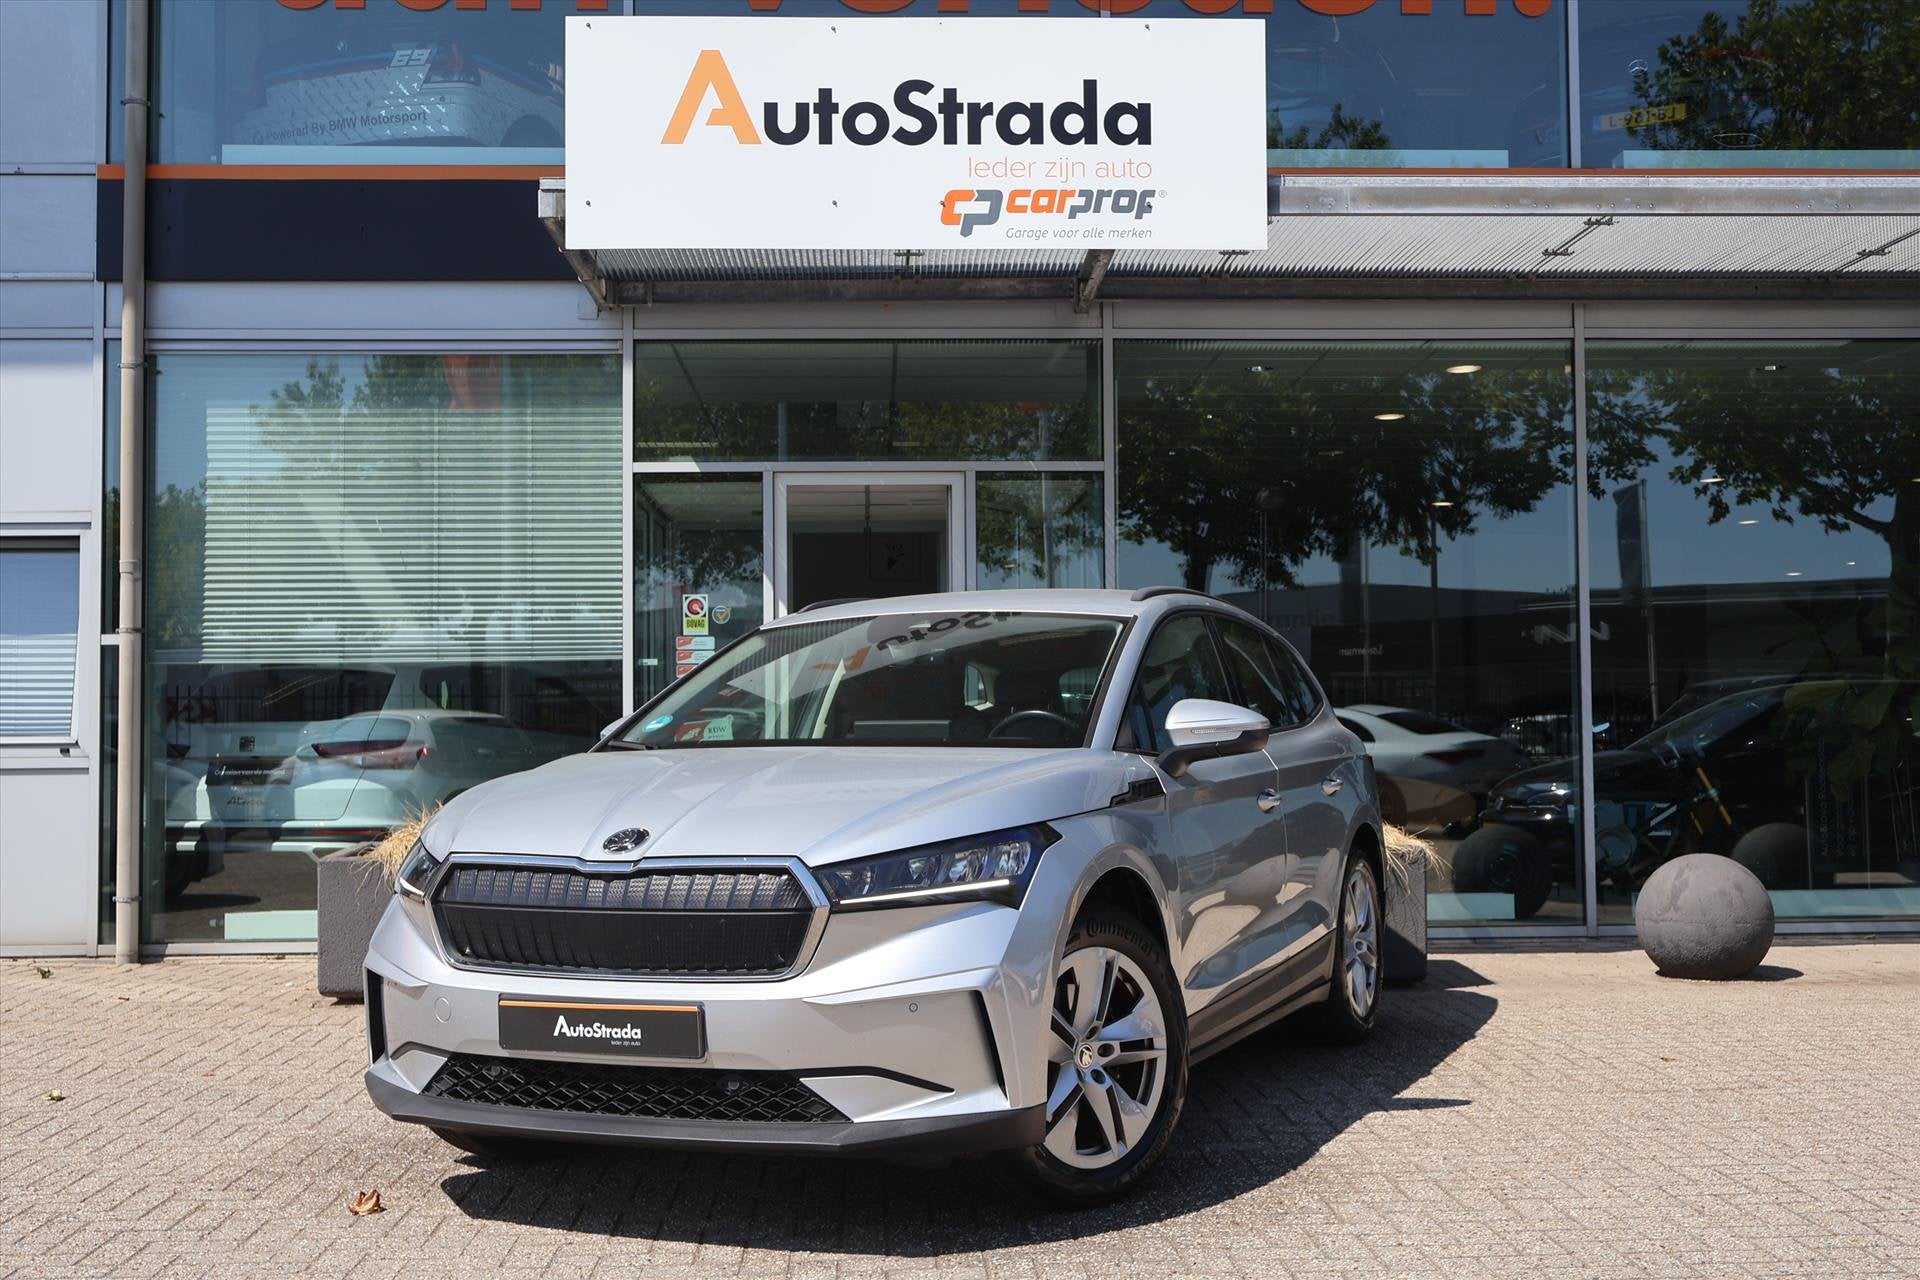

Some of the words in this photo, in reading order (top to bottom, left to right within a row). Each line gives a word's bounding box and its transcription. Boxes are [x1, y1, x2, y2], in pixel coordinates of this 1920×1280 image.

[661, 50, 1152, 146] AutoStrada
[267, 125, 308, 142] Powered
[311, 121, 326, 136] By
[328, 117, 358, 132] BMW
[360, 110, 429, 127] Motorsport
[969, 157, 1036, 178] Ieder
[1045, 157, 1086, 184] zijn
[1096, 159, 1152, 178] auto
[1006, 227, 1049, 240] Garage
[1052, 228, 1080, 238] voor
[1083, 227, 1105, 238] alle
[1107, 227, 1152, 238] merken
[686, 619, 705, 629] BOVAG
[1087, 918, 1153, 956] Continental
[553, 1014, 642, 1040] AutoStrada
